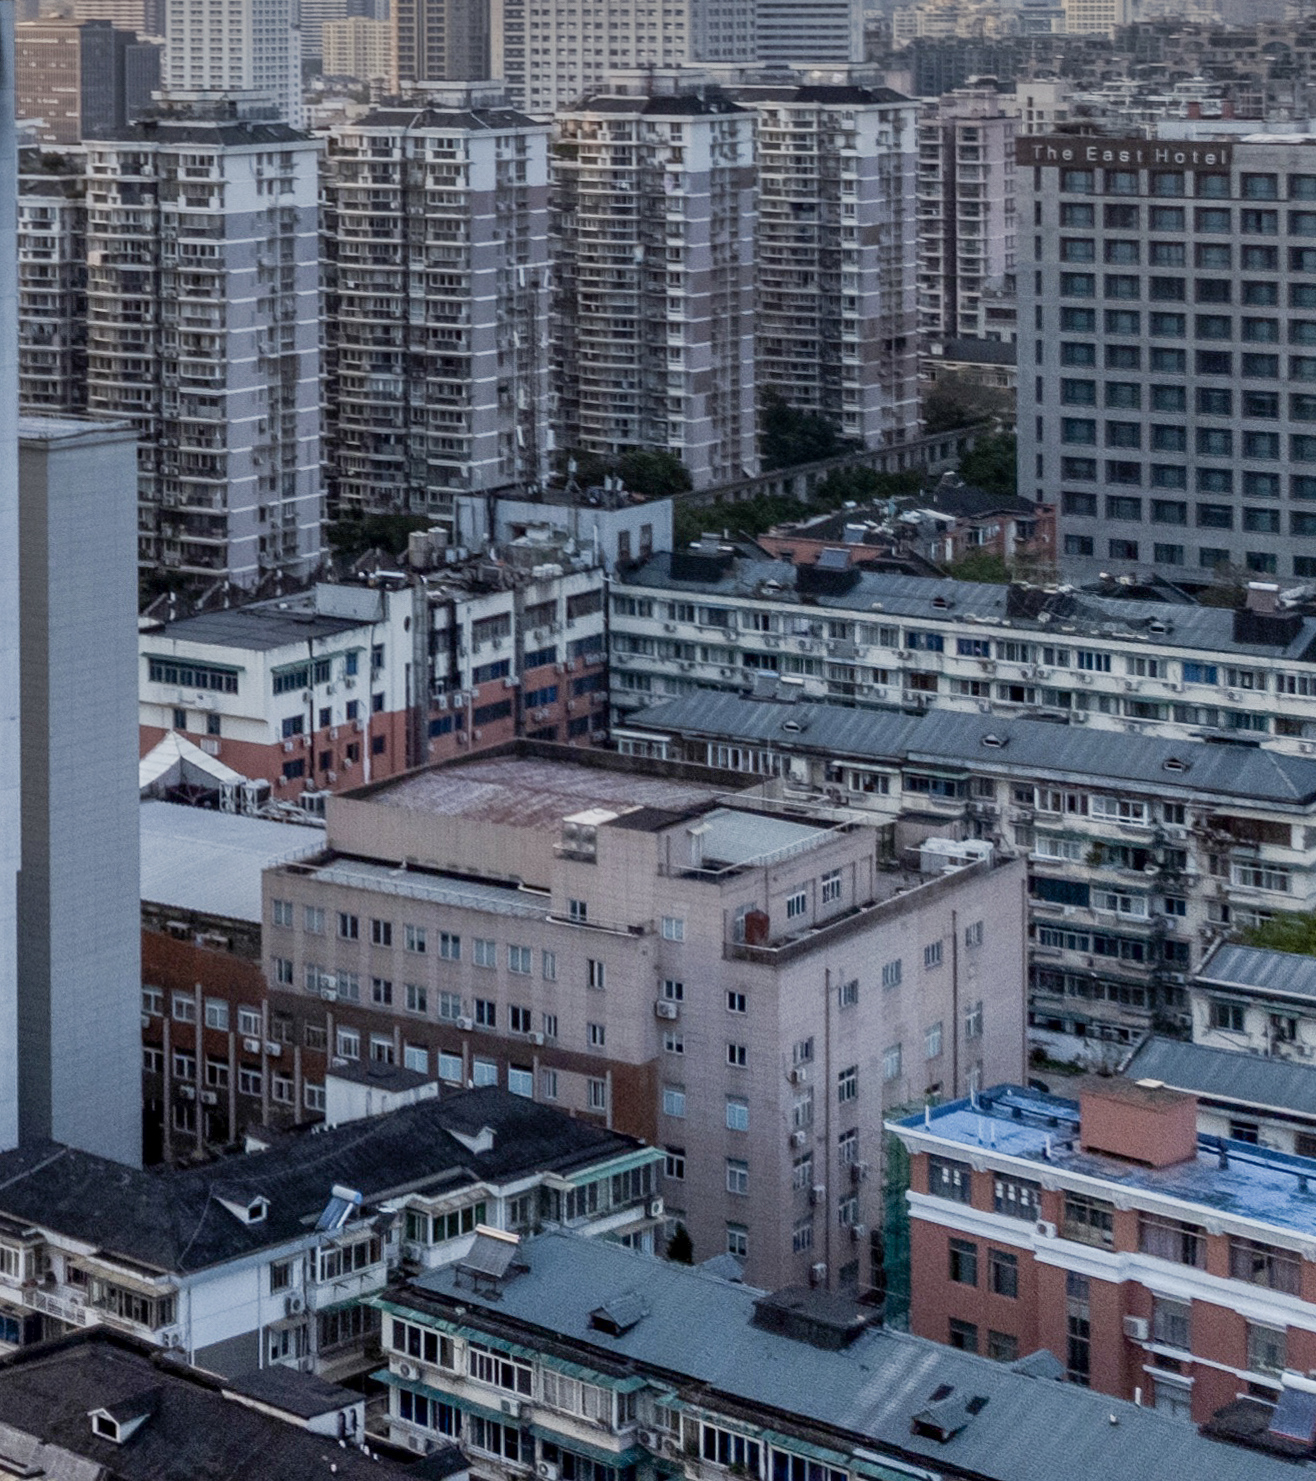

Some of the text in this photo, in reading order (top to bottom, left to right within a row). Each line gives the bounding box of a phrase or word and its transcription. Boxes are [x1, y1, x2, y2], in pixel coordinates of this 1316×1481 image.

[1032, 145, 1227, 166] The East Hotel
